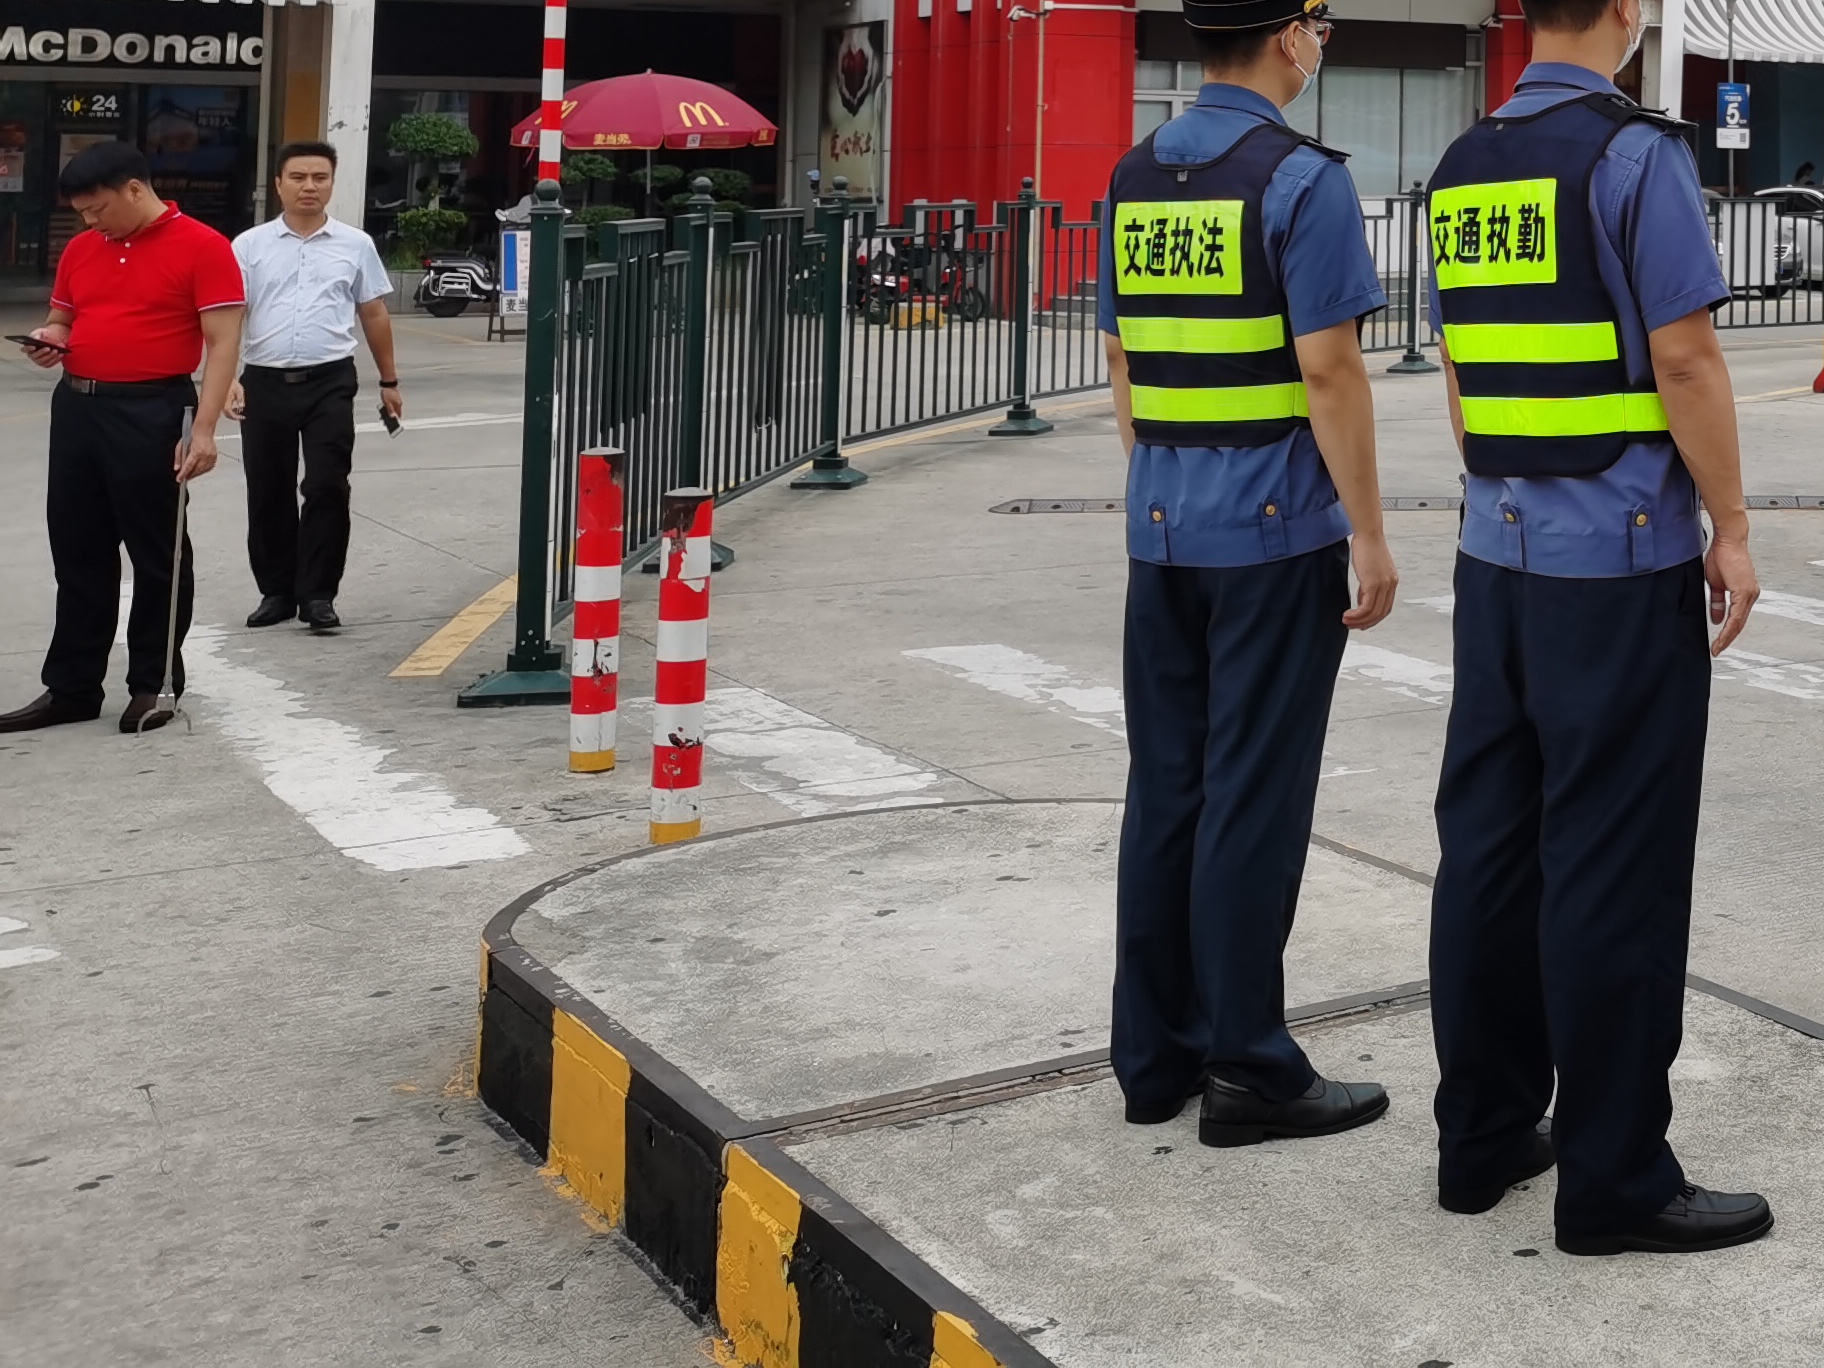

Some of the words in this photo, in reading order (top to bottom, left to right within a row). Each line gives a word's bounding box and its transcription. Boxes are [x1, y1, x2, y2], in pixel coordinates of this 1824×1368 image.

[91, 94, 118, 111] 24
[592, 133, 633, 146] 麦当劳
[1123, 216, 1226, 279] 交通执法
[1434, 202, 1547, 269] 交通执勤
